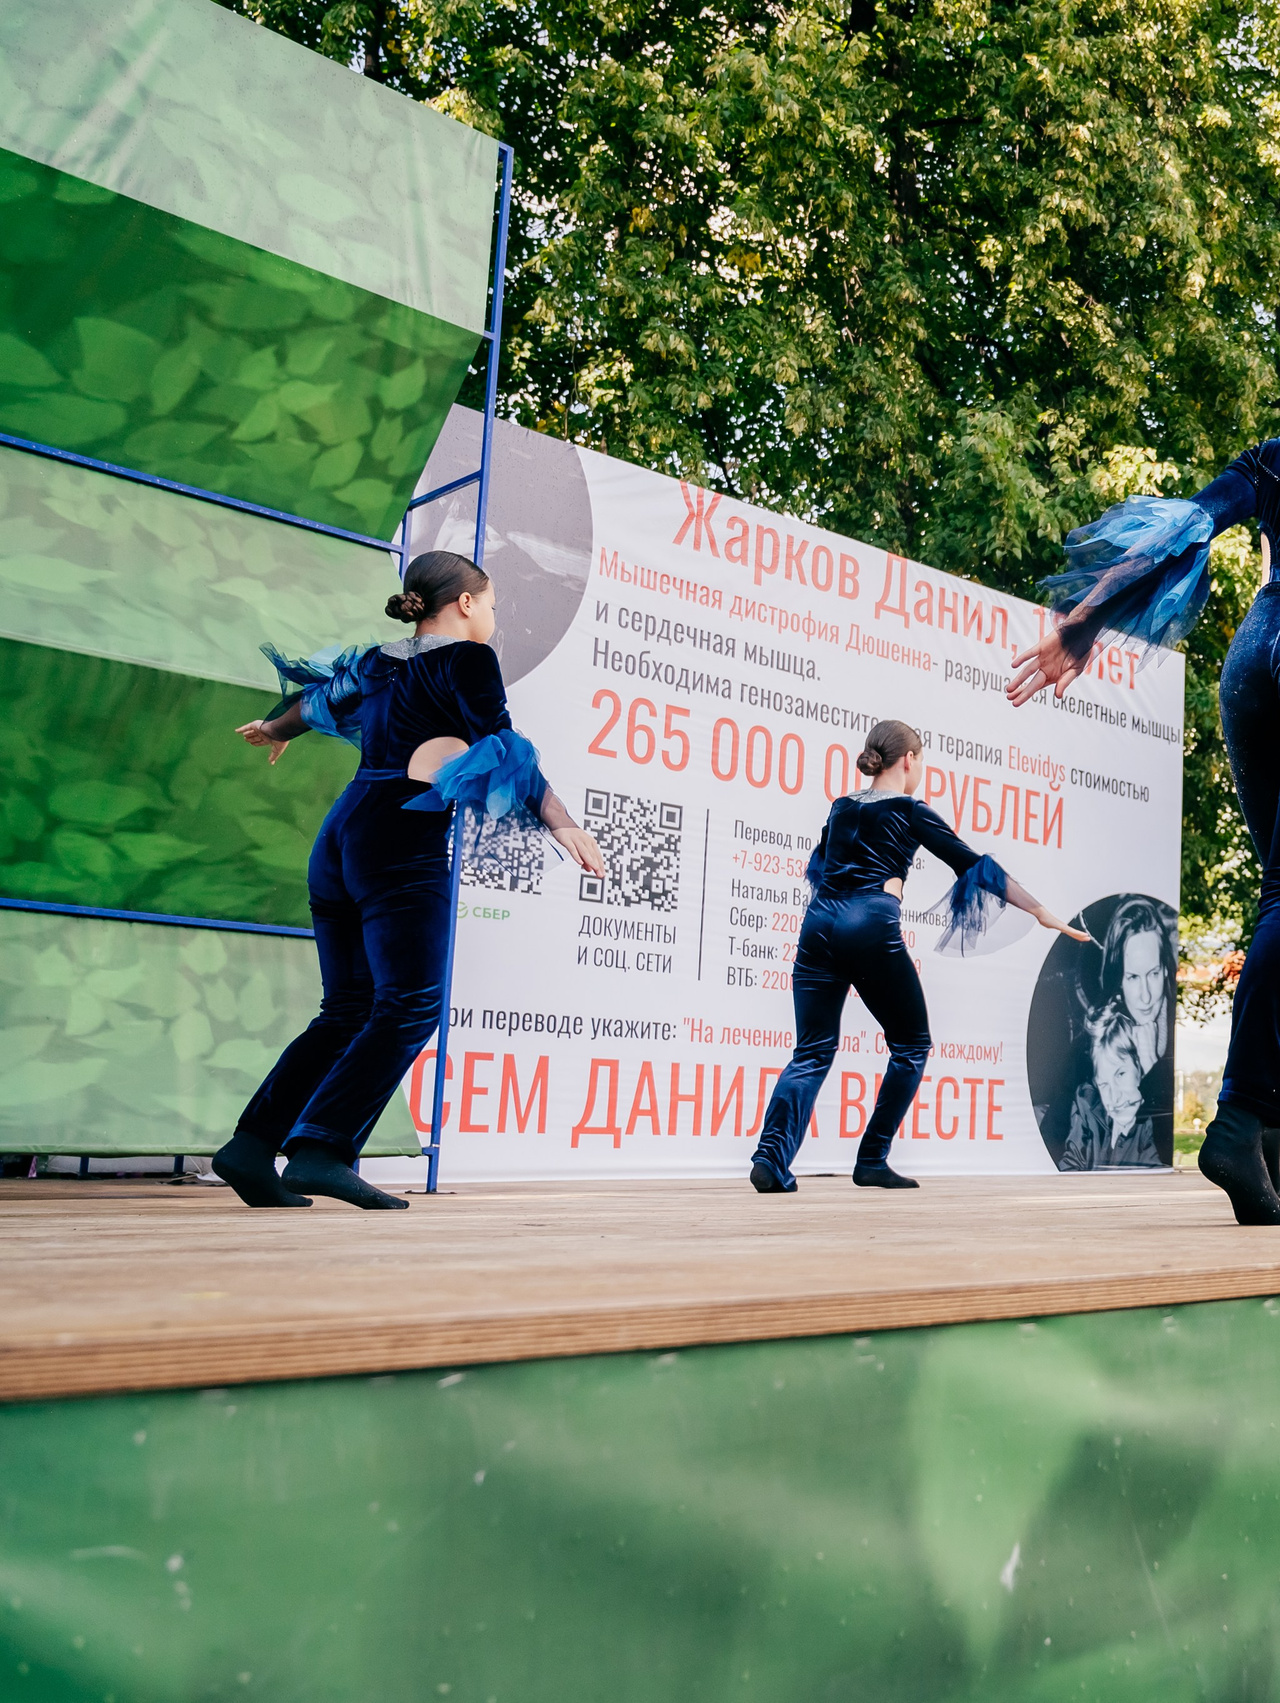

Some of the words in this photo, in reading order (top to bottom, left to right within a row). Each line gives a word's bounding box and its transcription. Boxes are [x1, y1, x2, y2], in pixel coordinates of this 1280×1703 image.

[672, 480, 860, 600] Жарков
[874, 552, 1018, 660] Данил,
[595, 600, 609, 624] и
[618, 607, 736, 658] сердечная
[743, 641, 821, 681] мышца.
[599, 546, 723, 610] Мышечная
[729, 595, 839, 645] дистрофия
[1131, 714, 1181, 745] мышцы
[592, 637, 732, 700] Необходима
[938, 733, 1002, 766] терапия
[1008, 745, 1066, 783] Elevidys
[1070, 768, 1150, 803] стоимостью
[587, 688, 691, 772] 265
[711, 717, 805, 795] 000
[924, 765, 1064, 849] РУБЛЕЙ
[734, 819, 793, 851] Перевод
[797, 835, 812, 851] по
[731, 878, 788, 905] Наталья
[472, 906, 510, 920] СБЕР
[729, 906, 768, 933] Сбер:
[771, 912, 804, 934] 220
[578, 914, 677, 945] ДОКУМЕНТЫ
[577, 945, 588, 965] И
[593, 947, 631, 973] СОЦ.
[635, 951, 672, 974] СЕТИ
[728, 936, 778, 961] Т-банк:
[727, 966, 758, 988] ВТБ:
[482, 1008, 583, 1039] переводе
[590, 1016, 677, 1041] укажите:
[683, 1016, 713, 1044] "На
[720, 1025, 793, 1049] лечение
[940, 1041, 1003, 1065] каждому!
[839, 1071, 1005, 1140] ВЕСТЕ
